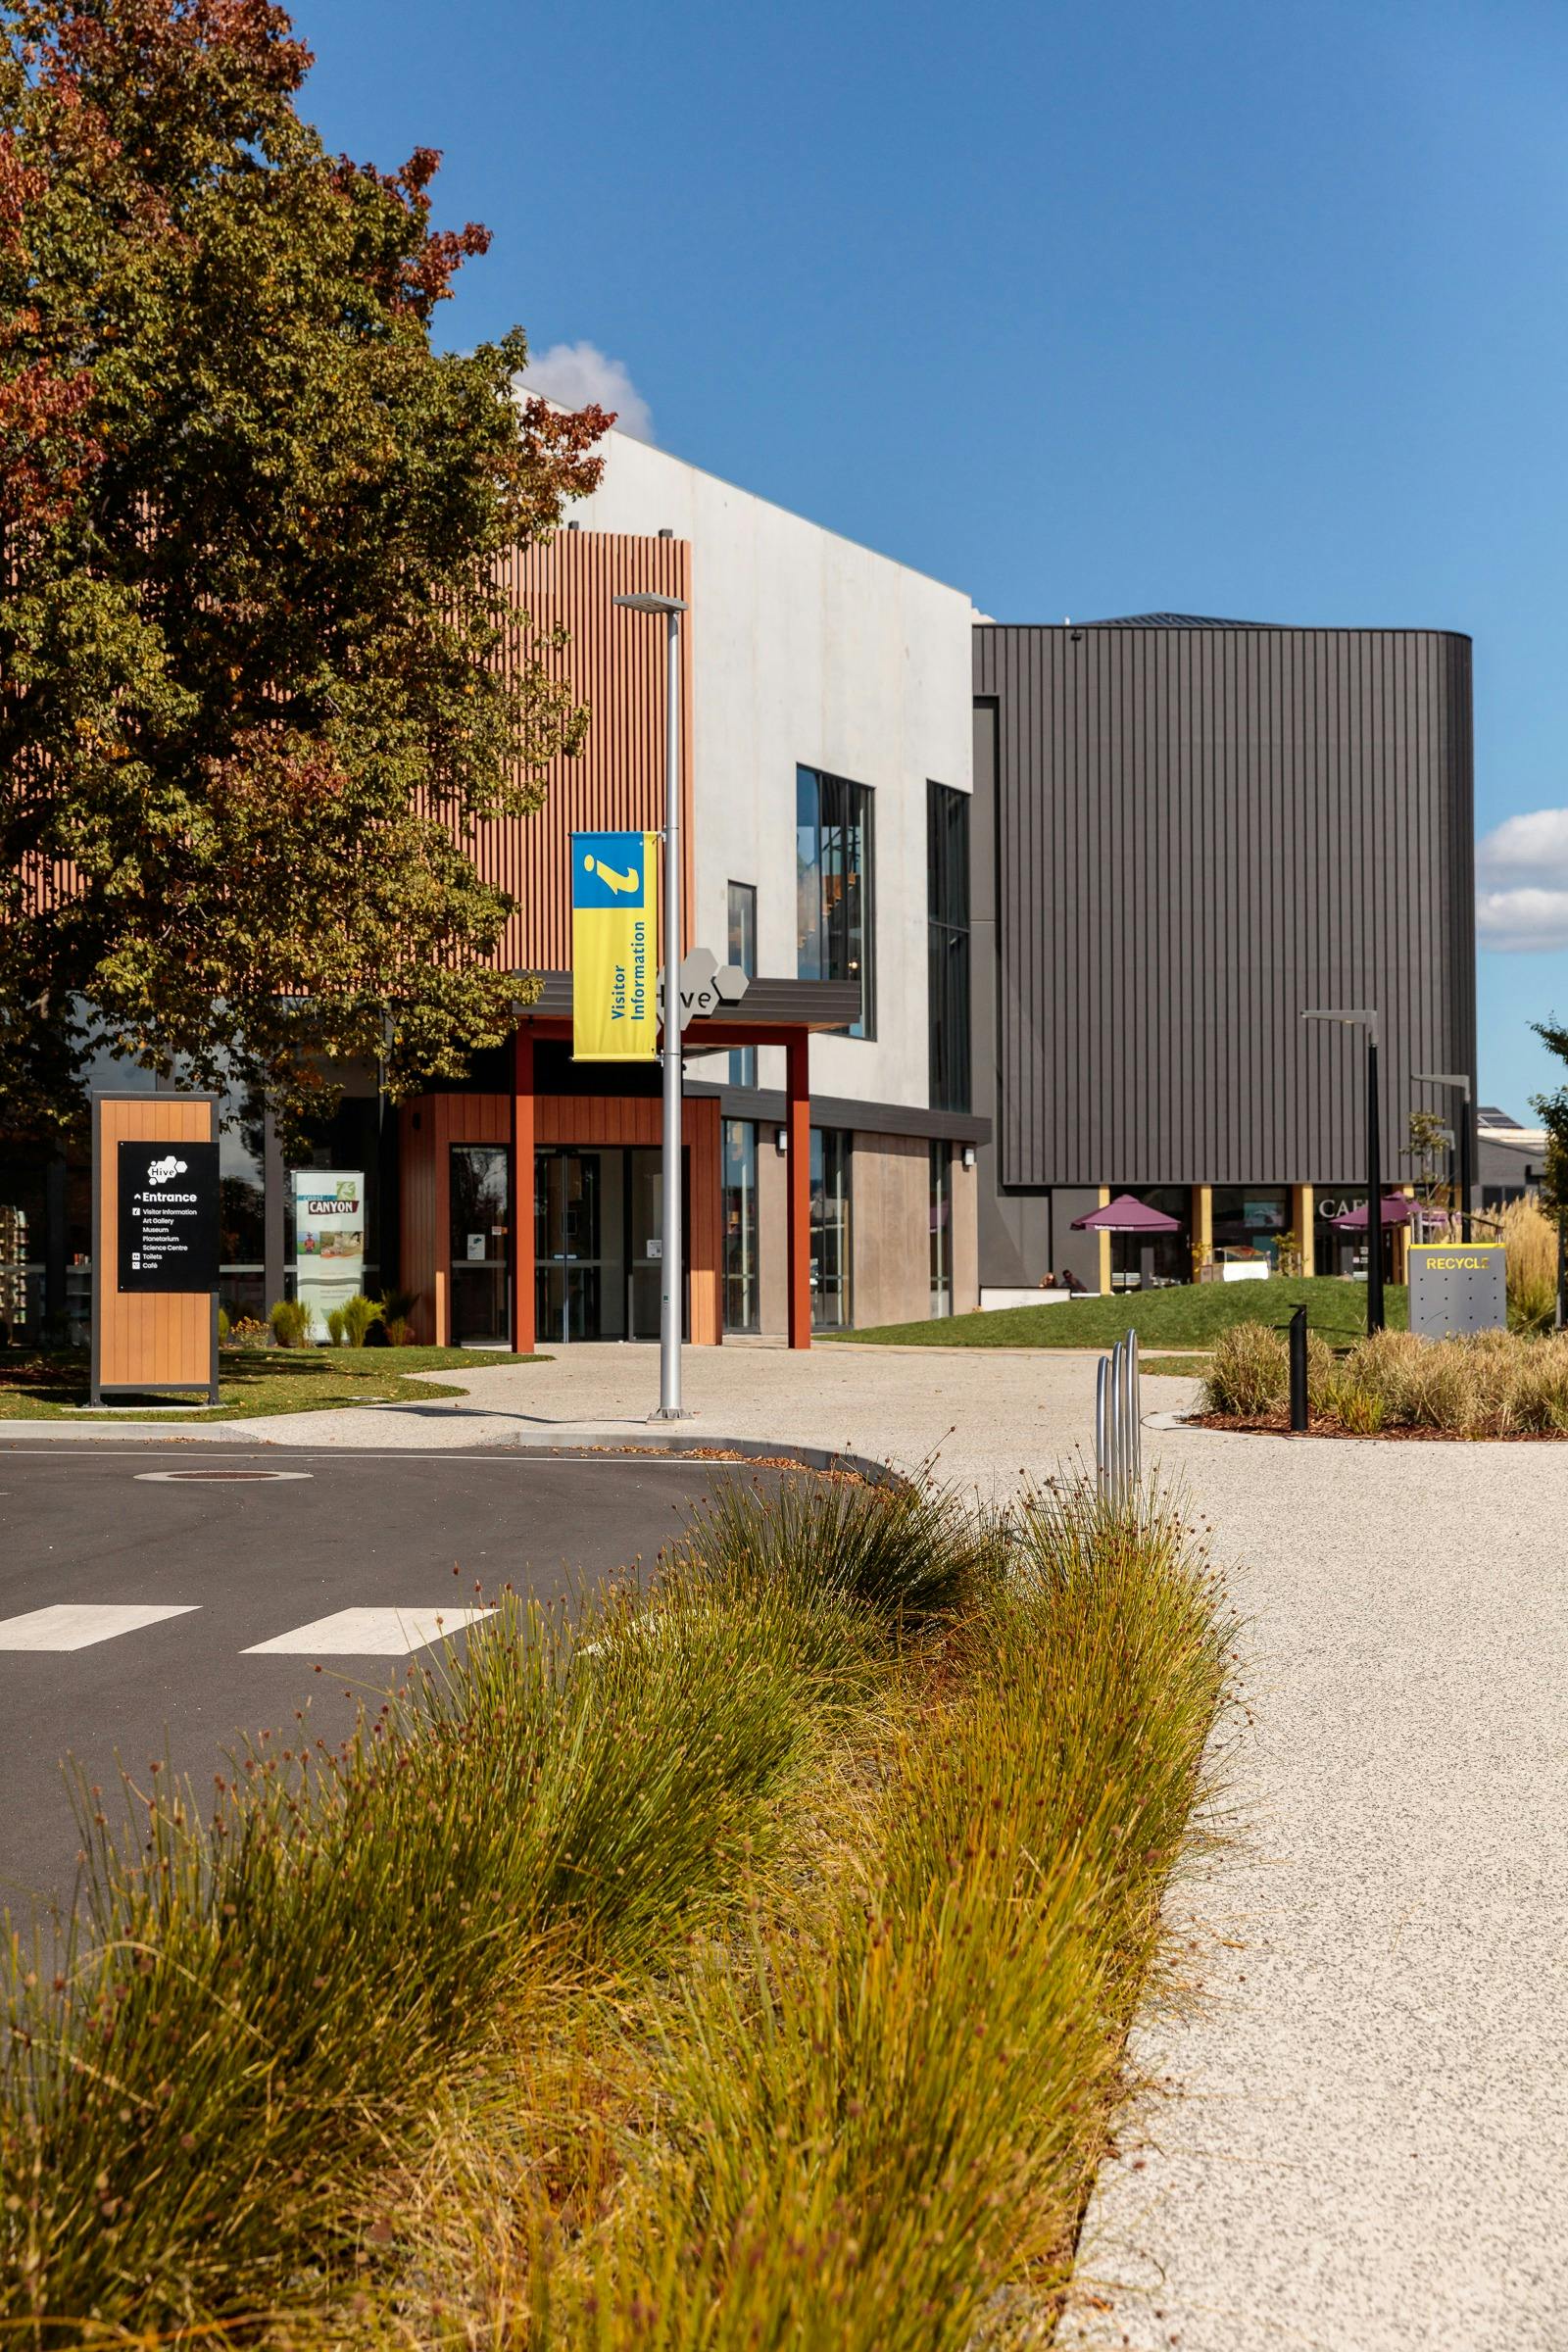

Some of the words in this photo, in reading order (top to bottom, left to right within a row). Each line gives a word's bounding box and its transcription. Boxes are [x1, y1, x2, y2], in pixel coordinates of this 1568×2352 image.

[630, 921, 646, 1020] Information
[611, 964, 626, 1020] Visitor
[142, 1192, 198, 1202] Entrance
[309, 1201, 353, 1213] CANYON
[1318, 1199, 1369, 1218] CAF
